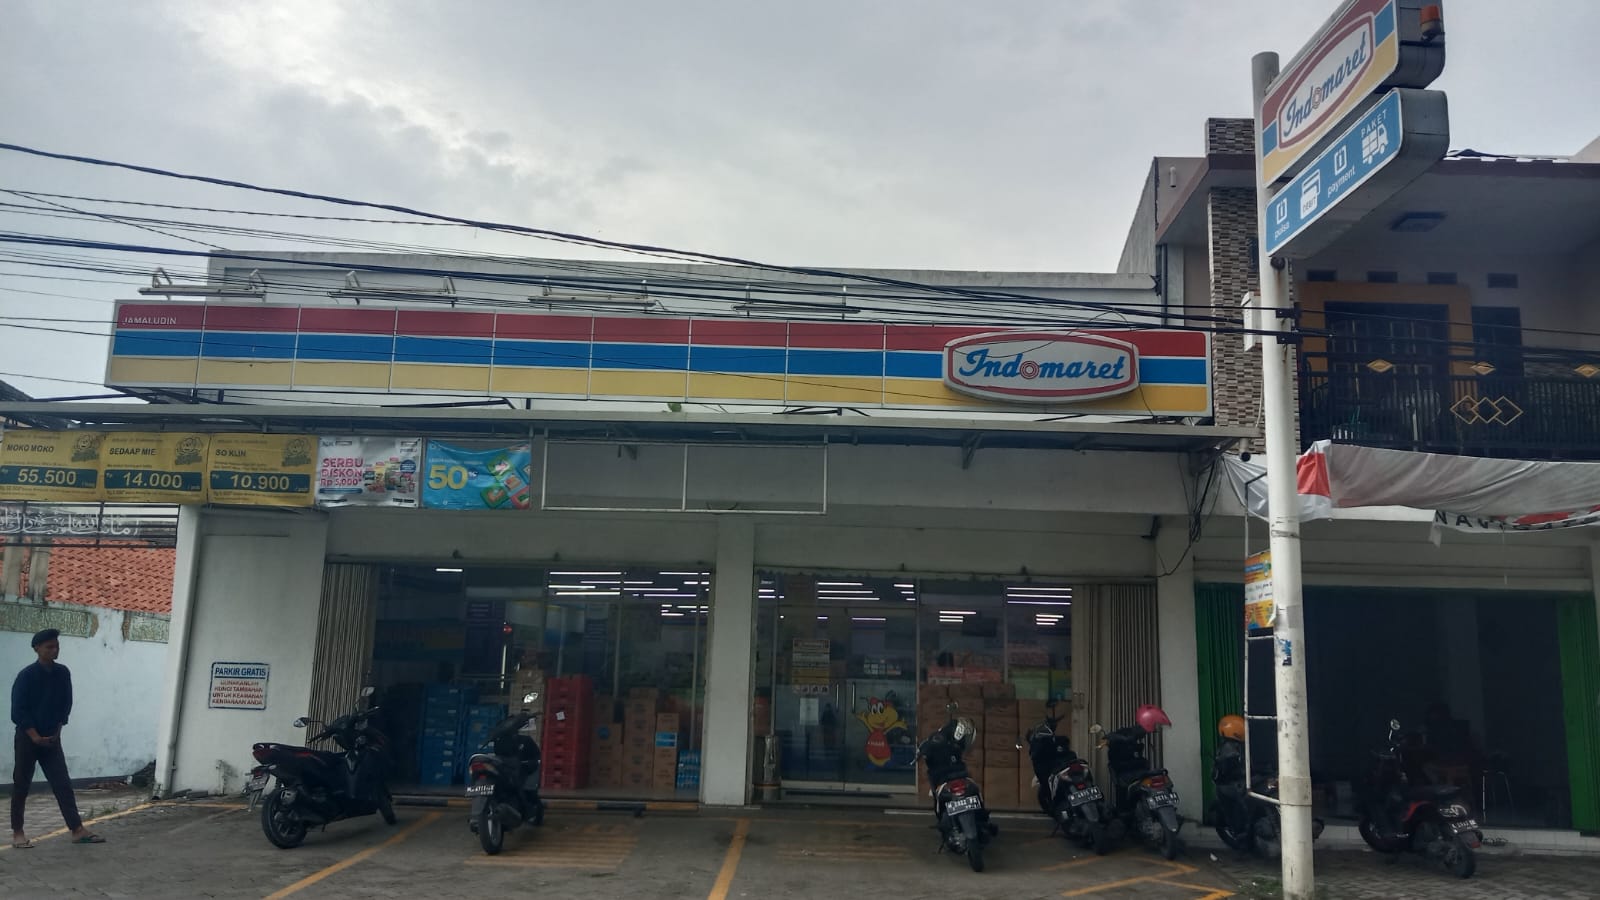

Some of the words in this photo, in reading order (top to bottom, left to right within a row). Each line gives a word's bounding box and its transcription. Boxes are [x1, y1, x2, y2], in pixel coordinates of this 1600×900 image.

[1283, 31, 1367, 137] Indomaret
[1361, 109, 1387, 137] PAKET
[1328, 165, 1356, 198] payment
[122, 316, 177, 325] JAMALUDIN
[958, 348, 1126, 380] Indomaret
[6, 443, 30, 452] MOKO
[31, 444, 54, 453] MOKO
[141, 448, 157, 456] MIE
[215, 449, 227, 457] SO
[322, 457, 364, 468] SERBU
[17, 468, 77, 485] 55.500
[321, 468, 363, 478] DISKON
[123, 471, 182, 489] 14.000
[230, 474, 290, 490] 10.900
[320, 479, 332, 487] Rp
[215, 667, 240, 676] PARKIR
[241, 668, 266, 676] GRATIS
